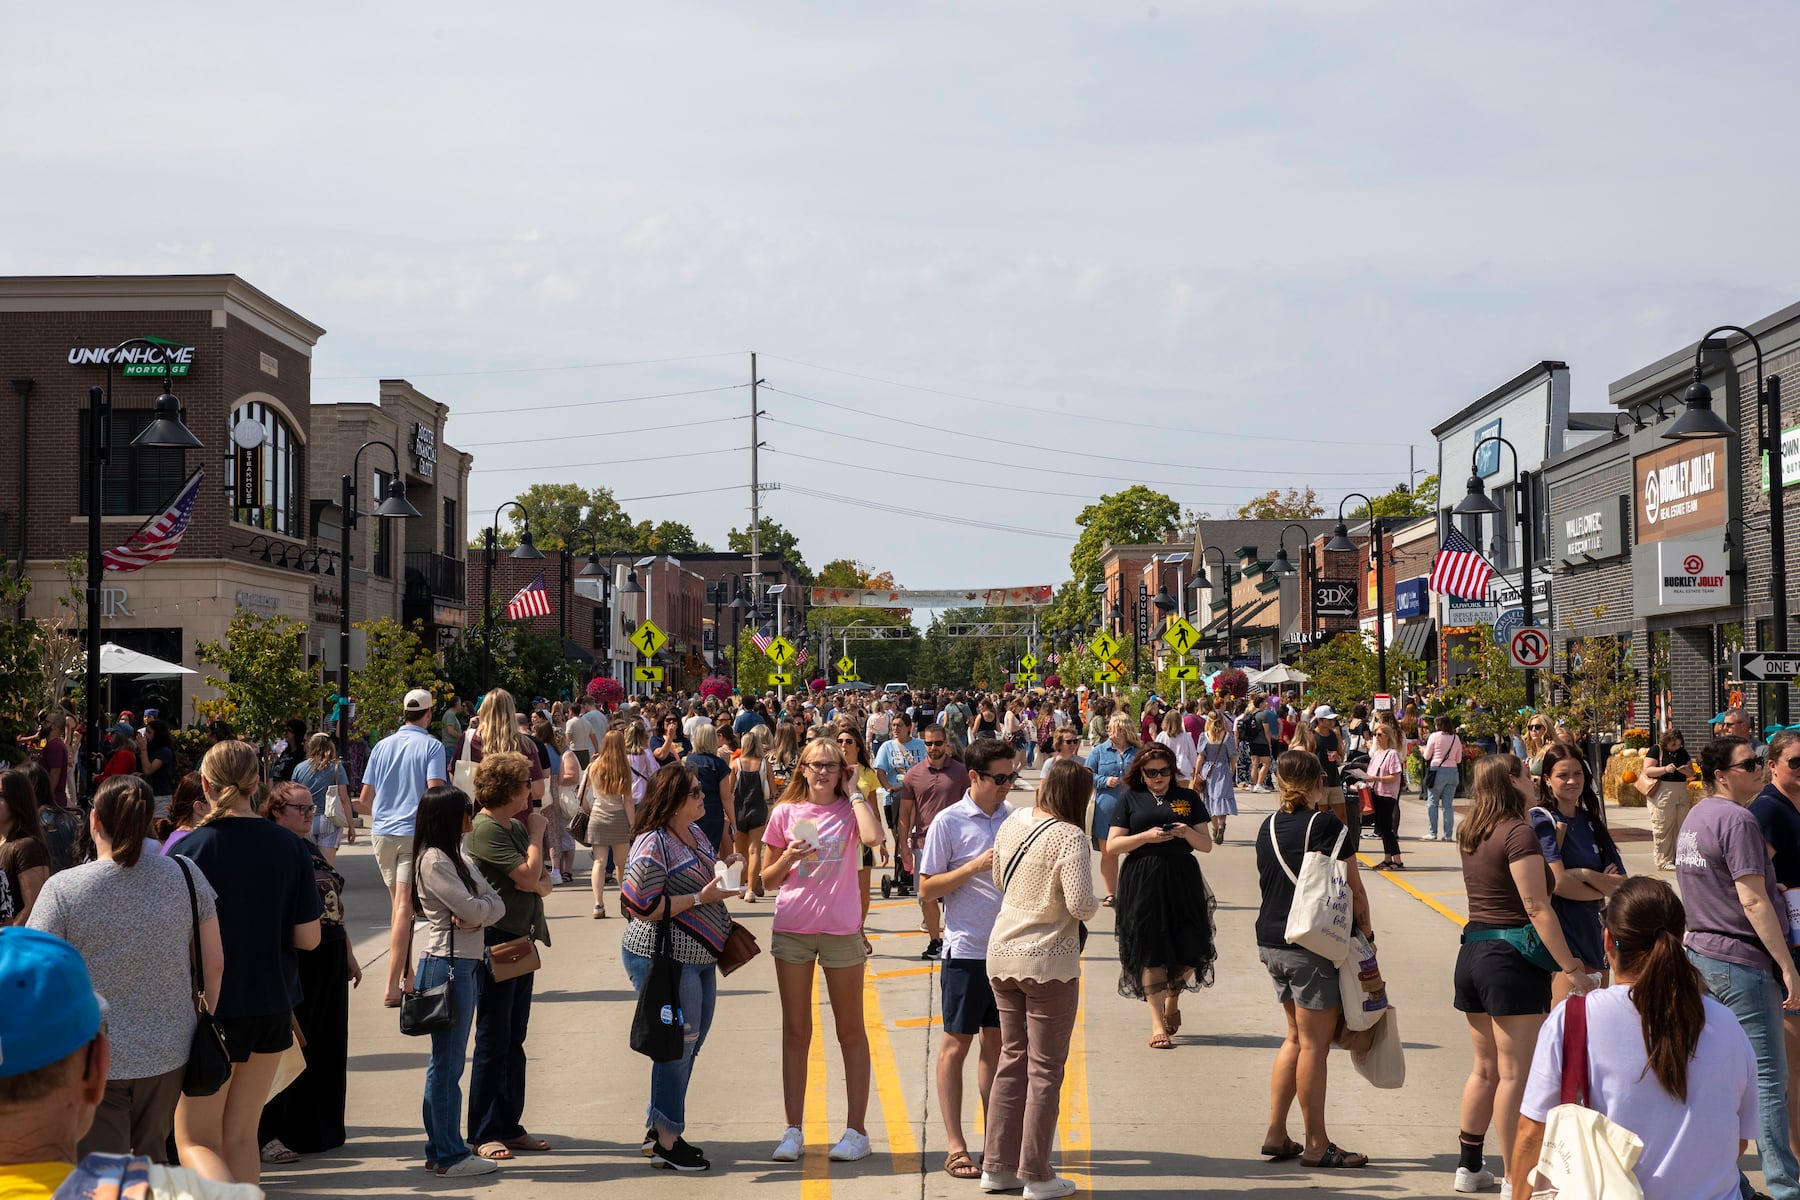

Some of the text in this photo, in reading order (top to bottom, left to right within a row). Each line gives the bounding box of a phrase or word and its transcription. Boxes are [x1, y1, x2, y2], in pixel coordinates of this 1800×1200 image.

[127, 366, 186, 374] MORTGGE
[1659, 451, 1715, 504] BUCKLEY JOLLEY
[1660, 499, 1698, 520] REAL ESTATE TEAM
[1664, 576, 1724, 587] BUCKLEY JOLLEY
[1766, 661, 1791, 673] ONE
